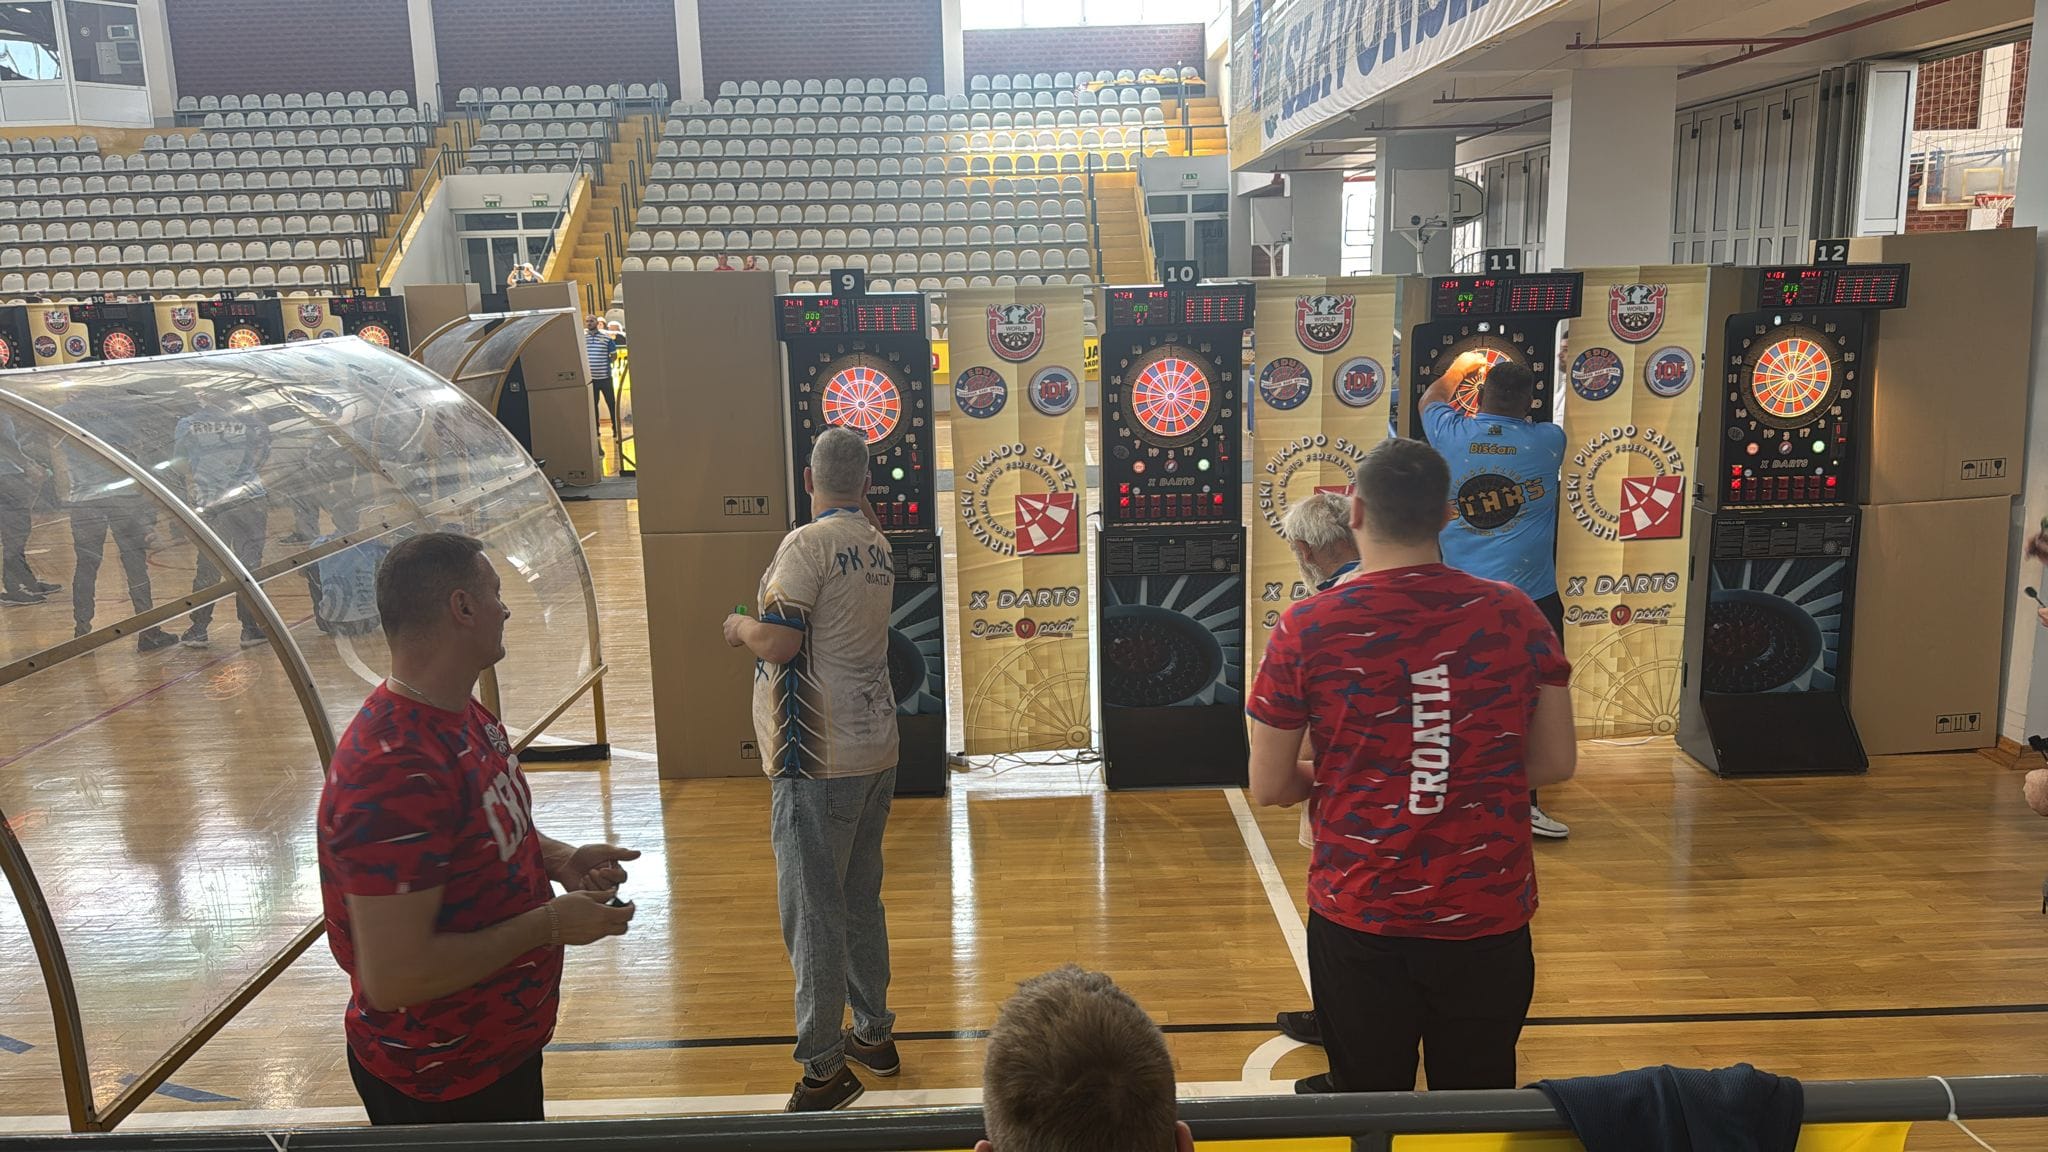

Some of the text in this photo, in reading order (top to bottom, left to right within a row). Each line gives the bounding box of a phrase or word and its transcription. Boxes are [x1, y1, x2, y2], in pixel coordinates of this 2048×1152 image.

[1490, 254, 1516, 270] 11
[1818, 246, 1844, 262] 12
[842, 274, 855, 290] 9
[1168, 266, 1194, 282] 10
[93, 296, 104, 304] 30
[222, 292, 233, 300] 31
[1838, 336, 1846, 346] 4
[1526, 346, 1534, 356] 4
[1732, 355, 1742, 366] 14
[1655, 360, 1686, 380] IDF
[1345, 372, 1376, 391] IDF
[1728, 374, 1737, 383] 11
[1040, 380, 1068, 399] IDF
[1840, 390, 1852, 398] 10
[1109, 394, 1118, 402] 11
[1736, 408, 1747, 418] 16
[1120, 428, 1130, 437] 16
[1750, 421, 1757, 430] 7
[1763, 429, 1774, 438] 19
[1800, 428, 1810, 438] 17
[1783, 432, 1790, 440] 3
[1184, 446, 1194, 456] 17
[1574, 424, 1637, 466] PIKADO
[1644, 428, 1684, 474] SAVEZ
[876, 456, 888, 464] 17
[1266, 434, 1326, 474] PIKADO
[1616, 444, 1666, 476] FEDERATION
[1760, 459, 1808, 468] X DARTS
[1006, 461, 1058, 492] FEDERATION
[960, 442, 1076, 556] HRVATSKI PIKADO SAVEZ
[1566, 473, 1616, 540] HRVATSKI
[836, 545, 864, 576] PK
[1262, 582, 1282, 601] X
[1566, 572, 1679, 596] X DARTS
[969, 587, 1080, 610] X DARTS
[1564, 604, 1672, 624] Darts point
[971, 616, 1076, 638] Darts point
[1408, 664, 1450, 814] CROATIA
